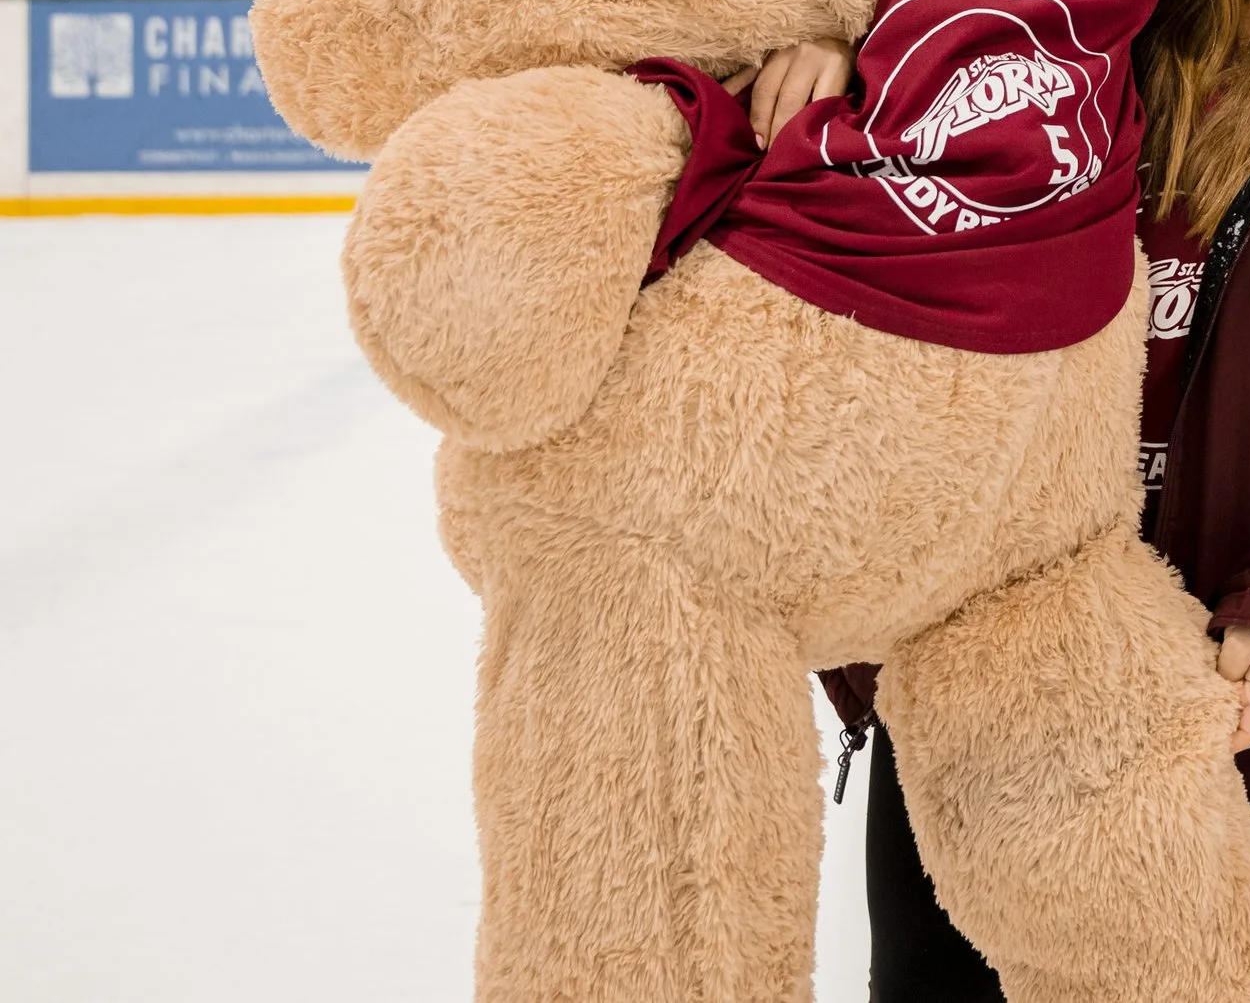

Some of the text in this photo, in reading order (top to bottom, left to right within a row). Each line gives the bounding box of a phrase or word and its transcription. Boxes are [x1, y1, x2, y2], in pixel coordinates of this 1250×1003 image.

[968, 57, 986, 78] ST.
[901, 49, 1076, 165] STORM
[1042, 124, 1079, 185] 5
[1177, 262, 1195, 276] ST.
